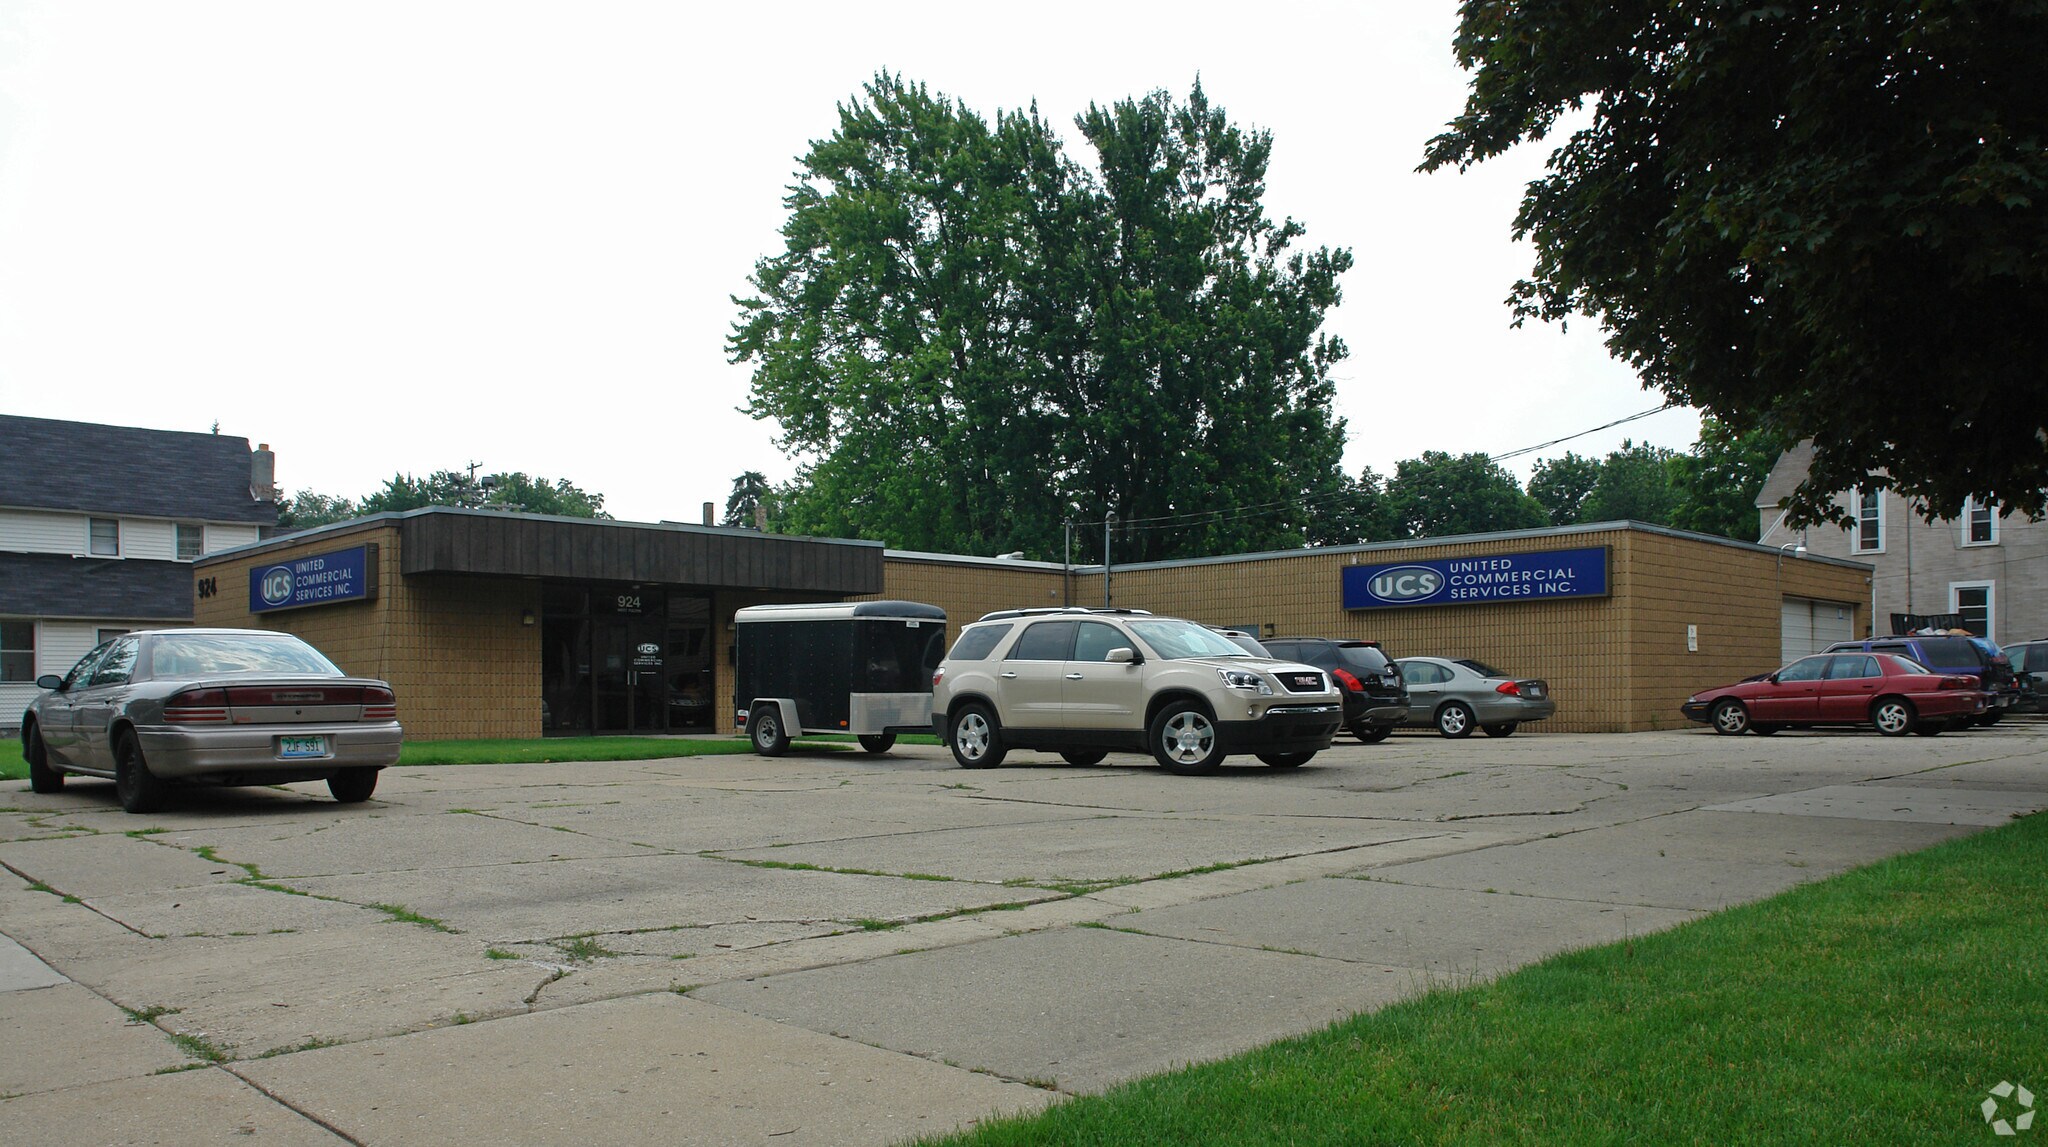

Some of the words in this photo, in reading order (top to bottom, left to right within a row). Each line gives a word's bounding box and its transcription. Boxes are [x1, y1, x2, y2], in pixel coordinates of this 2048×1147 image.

[295, 559, 324, 573] UNITED
[1450, 559, 1512, 573] UNITED
[295, 568, 352, 588] COMMERCIAL
[1374, 573, 1437, 598] UCS
[1450, 568, 1576, 586] COMMERCIAL
[198, 576, 217, 599] 924
[263, 576, 291, 599] UCS
[295, 587, 333, 601] SERVICES
[335, 583, 353, 596] INC.
[1450, 584, 1532, 599] SERVICES
[1539, 581, 1577, 595] INC.
[617, 595, 641, 608] 924
[640, 645, 657, 653] UCS
[1294, 676, 1318, 686] GMC
